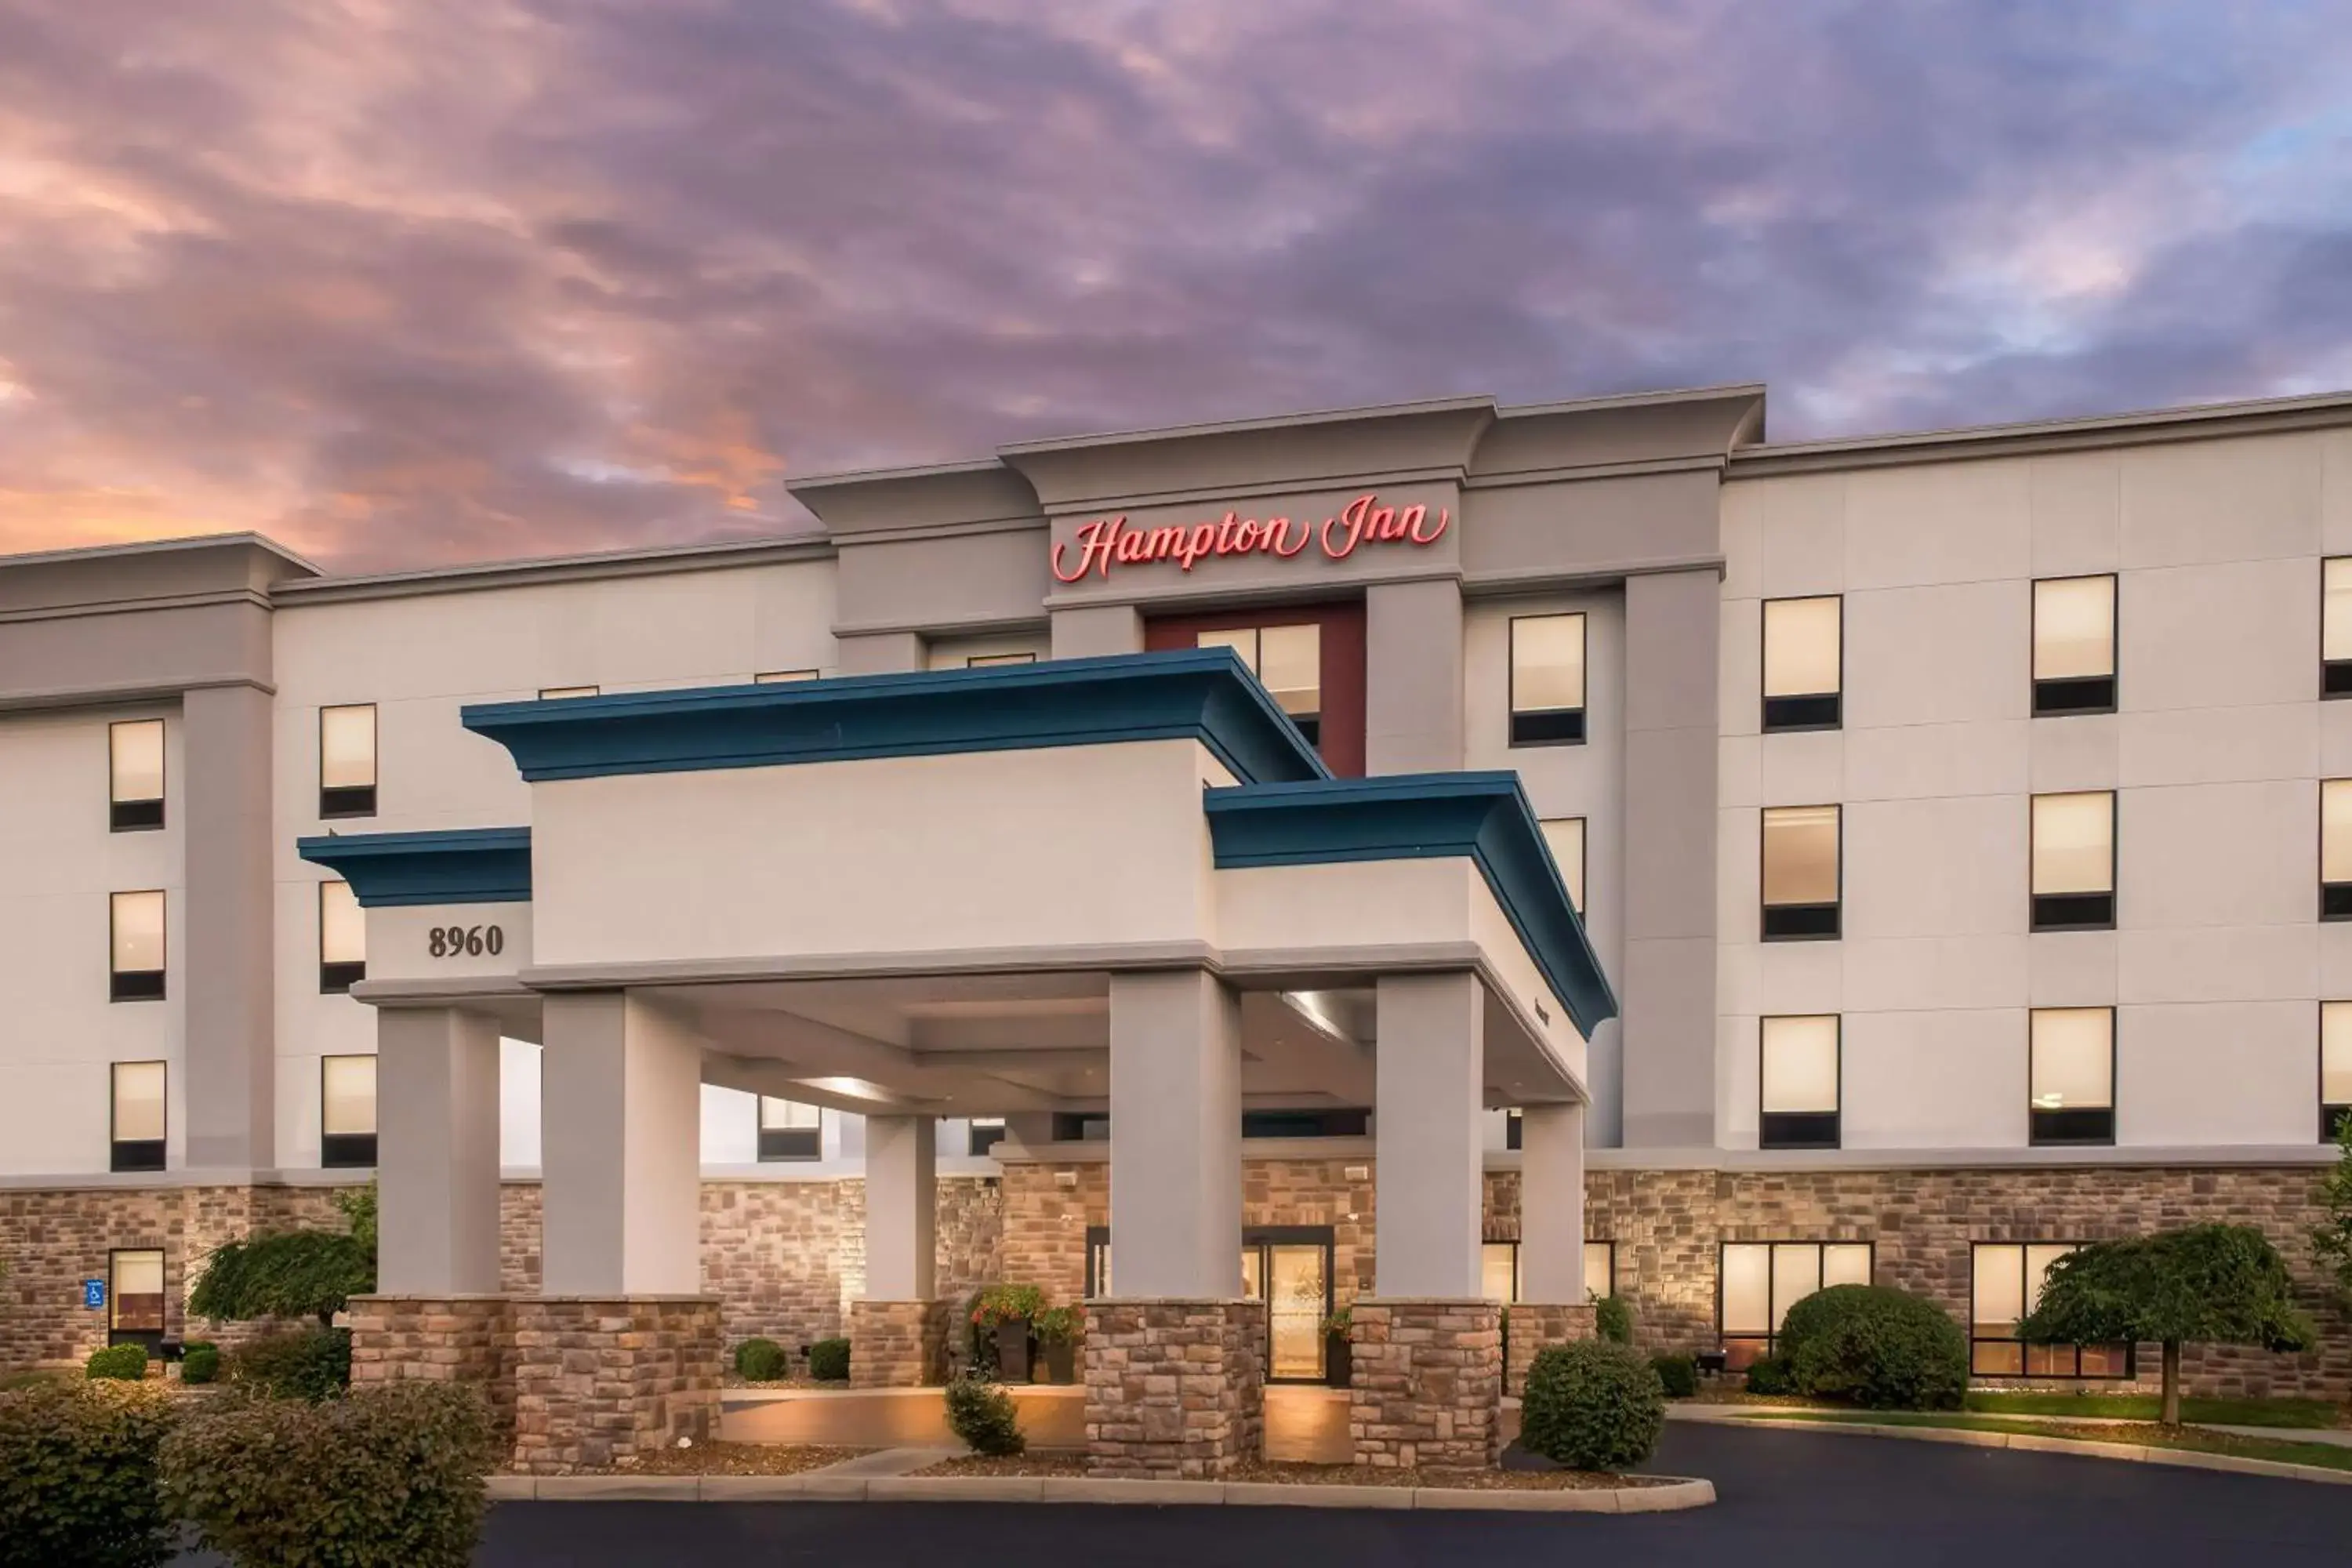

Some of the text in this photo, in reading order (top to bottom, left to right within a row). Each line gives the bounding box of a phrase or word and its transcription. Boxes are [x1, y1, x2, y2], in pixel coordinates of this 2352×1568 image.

[1052, 493, 1449, 583] Hampton Inn
[429, 924, 503, 957] 8960
